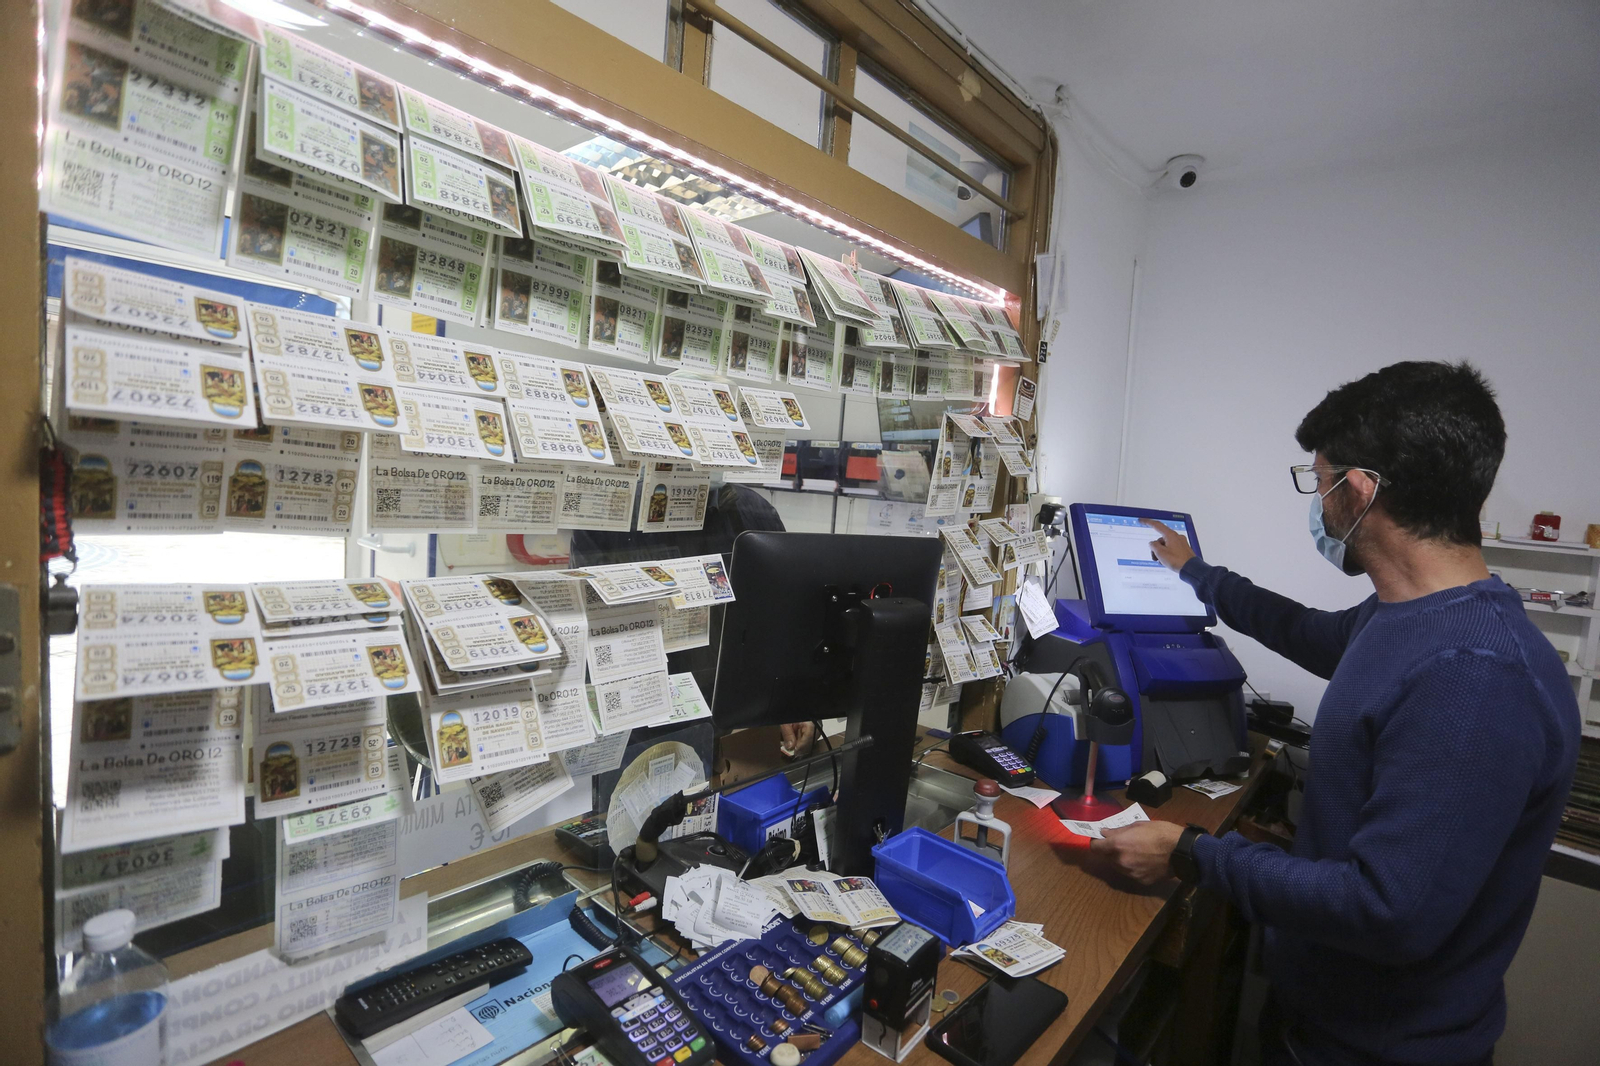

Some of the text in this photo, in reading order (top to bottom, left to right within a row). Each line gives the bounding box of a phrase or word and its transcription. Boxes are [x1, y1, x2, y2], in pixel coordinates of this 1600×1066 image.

[298, 73, 358, 106] 07521
[432, 124, 481, 151] 32848
[300, 144, 361, 174] 07521
[439, 189, 490, 212] 32848
[289, 211, 348, 239] 07521
[557, 214, 600, 230] 87999
[417, 251, 465, 273] 32848
[646, 255, 680, 271] 08211
[764, 258, 787, 272] 31382
[532, 281, 570, 301] 87999
[619, 304, 647, 320] 08211
[774, 303, 797, 314] 31382
[111, 305, 192, 328] 72607
[686, 323, 713, 337] 82533
[750, 338, 771, 349] 31382
[874, 333, 896, 342] 36624
[284, 343, 344, 362] 12782
[417, 371, 466, 385] 13044
[112, 389, 195, 408] 72607
[525, 388, 566, 401] 86883
[617, 395, 651, 407] 14338
[296, 402, 360, 419] 12782
[692, 406, 720, 417] 19167
[763, 415, 789, 424] 08636
[425, 435, 475, 448] 13044
[541, 442, 583, 454] 86883
[639, 439, 673, 450] 14338
[711, 451, 740, 460] 19167
[127, 463, 199, 479] 72607
[278, 469, 334, 485] 12782
[376, 465, 389, 476] La
[391, 466, 416, 478] Bolsa
[418, 468, 430, 479] De
[482, 475, 526, 487] La Bolsa De
[566, 474, 576, 483] La
[576, 475, 594, 485] Bolsa
[671, 488, 698, 497] 19167
[684, 589, 713, 601] 71813
[293, 602, 353, 611] 12729
[443, 600, 491, 611] 12019
[121, 614, 198, 624] 20674
[591, 623, 629, 637] La Bolsa De
[468, 645, 518, 658] 12019
[122, 670, 205, 686] 20674
[306, 679, 369, 696] 12729
[538, 693, 549, 703] De
[223, 714, 234, 722] 20
[473, 706, 520, 722] 12019
[306, 735, 361, 755] 12729
[315, 805, 372, 828] 69375
[306, 893, 334, 906] Bolsa
[336, 888, 350, 898] De
[994, 933, 1021, 948] 69375
[674, 964, 703, 983] ESPECIALISTAS
[707, 951, 722, 964] IMAGEN
